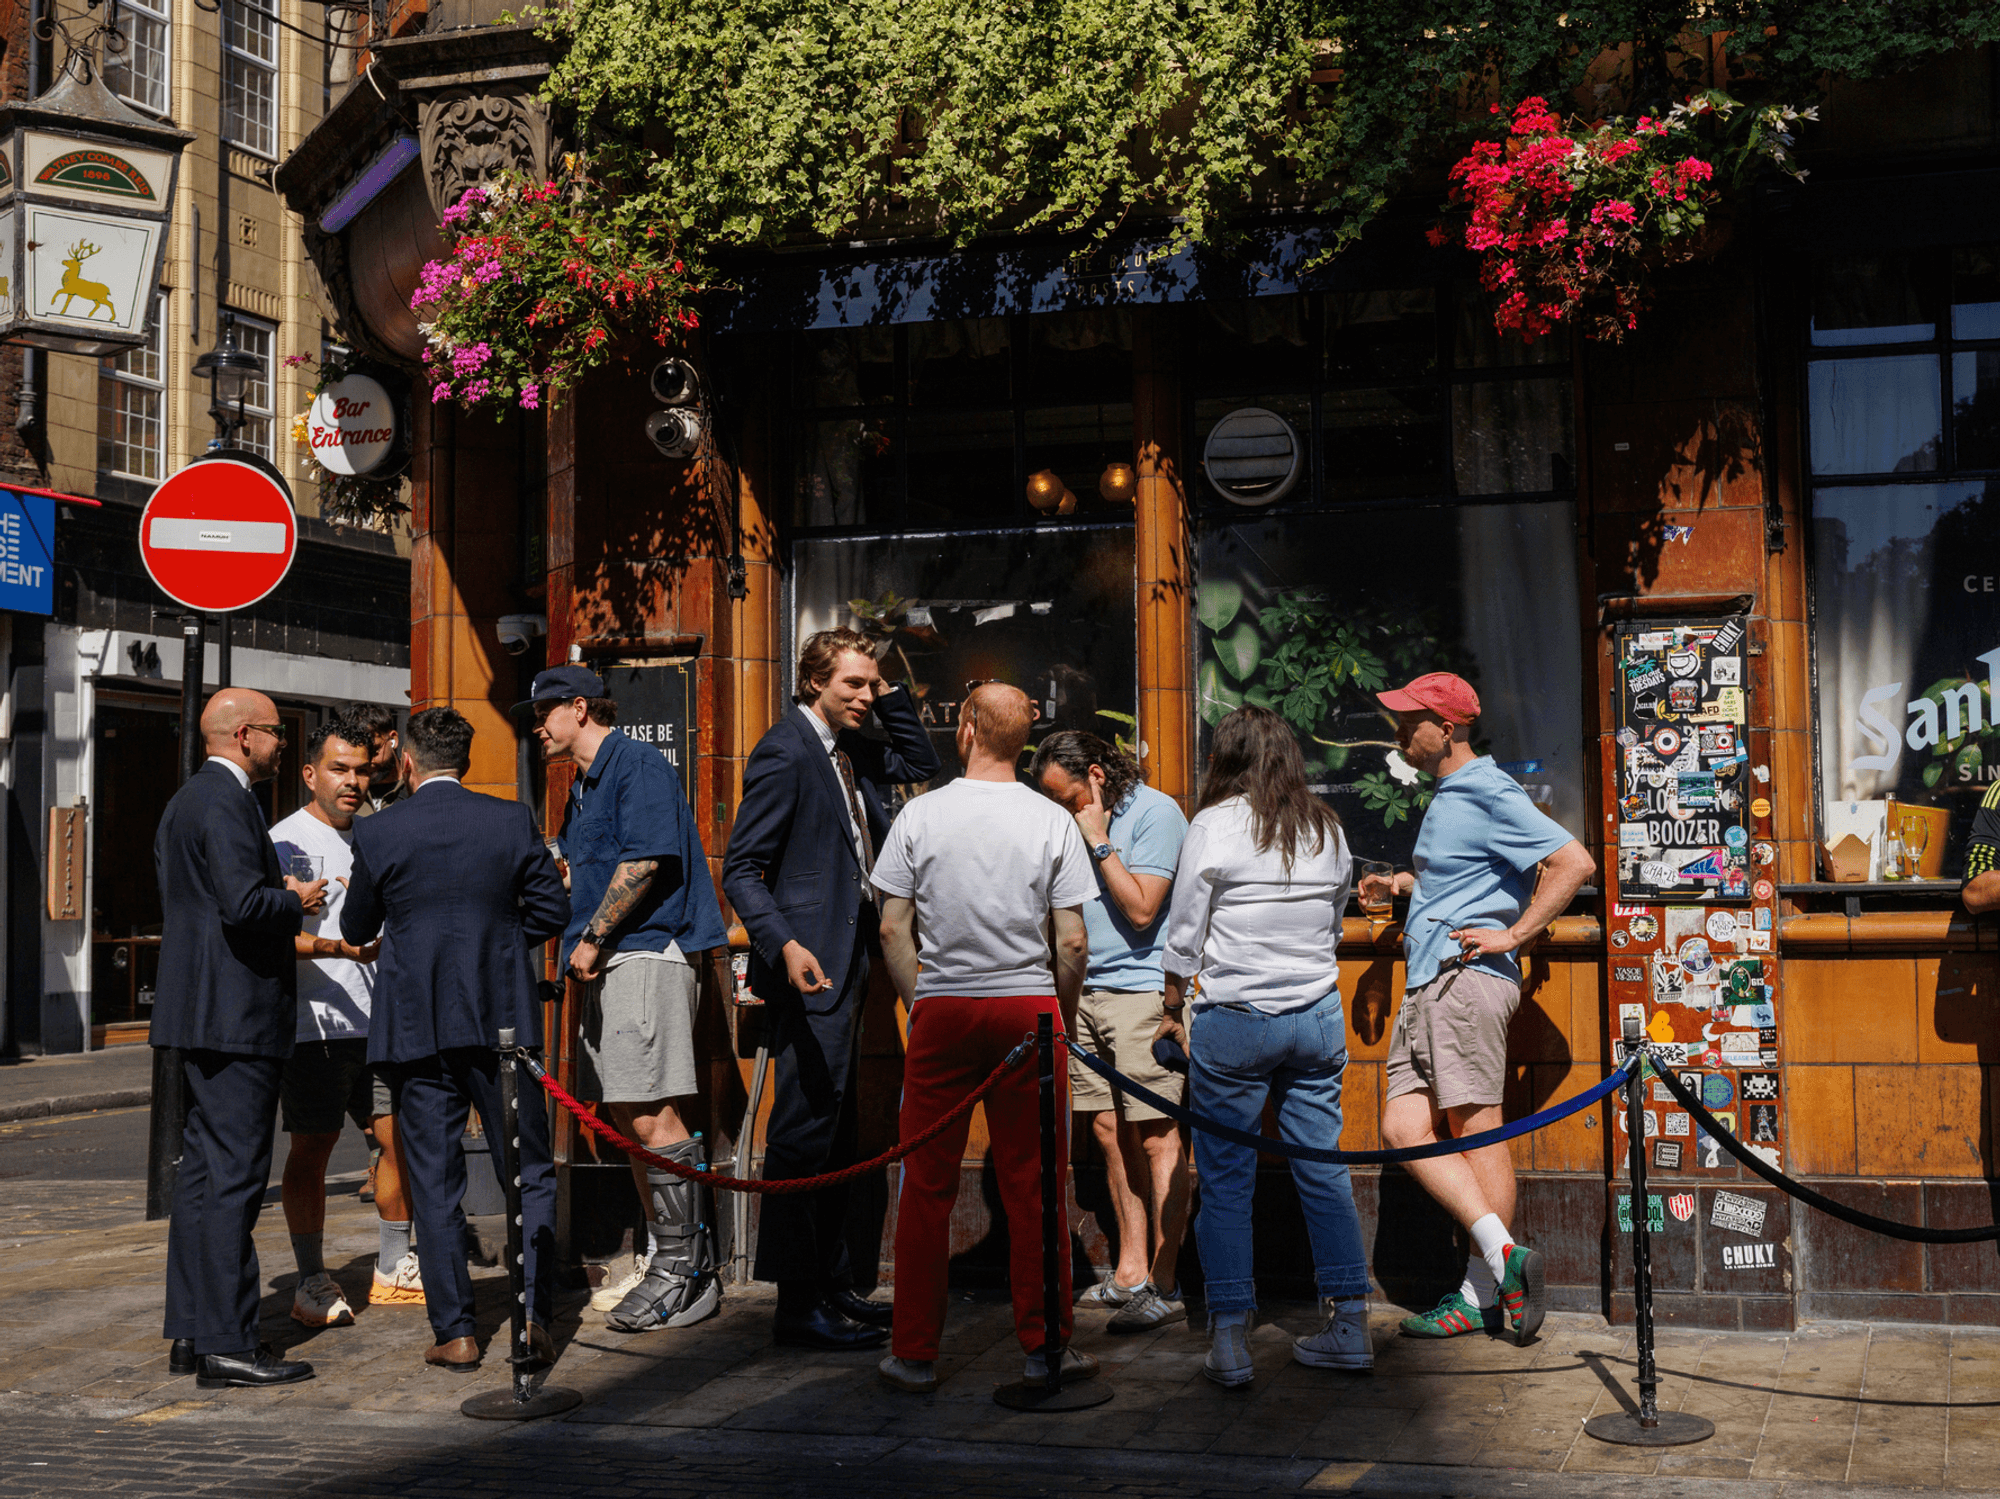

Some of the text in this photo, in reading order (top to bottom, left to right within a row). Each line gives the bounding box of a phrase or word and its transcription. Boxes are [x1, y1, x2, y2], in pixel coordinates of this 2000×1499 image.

[39, 152, 87, 181] WATNEY
[86, 152, 130, 174] COMBE
[128, 170, 150, 196] REID
[82, 169, 111, 181] 1898
[1061, 257, 1092, 274] THE
[1077, 279, 1135, 301] POSTS
[332, 397, 371, 420] Bar
[311, 425, 393, 450] Entrance
[1711, 619, 1742, 655] CHUKY
[126, 639, 158, 671] 14
[609, 723, 674, 742] EASE BE
[1849, 681, 1983, 773] San
[1649, 818, 1721, 846] BOOZER
[1722, 1243, 1775, 1266] CHUKY
